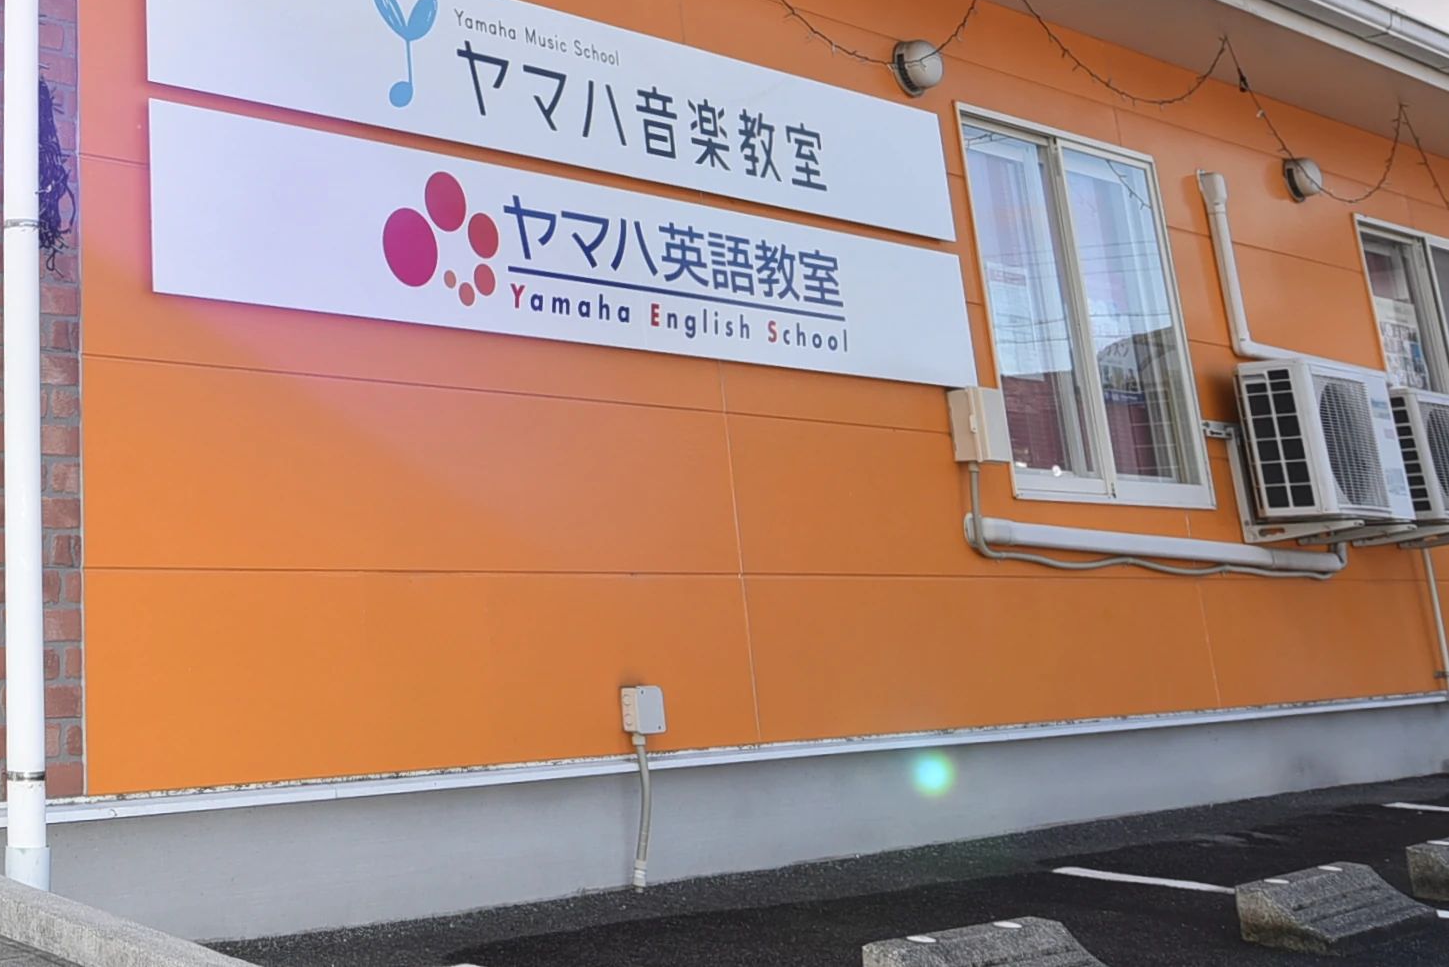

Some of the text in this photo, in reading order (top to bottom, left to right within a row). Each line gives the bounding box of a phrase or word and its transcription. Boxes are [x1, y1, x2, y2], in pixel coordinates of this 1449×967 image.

[454, 8, 620, 67] Yamaha Music School
[456, 40, 828, 192] ヤマハ音楽教室
[503, 194, 845, 308] ヤマハ英語教室
[510, 283, 847, 352] Yamaha English School
